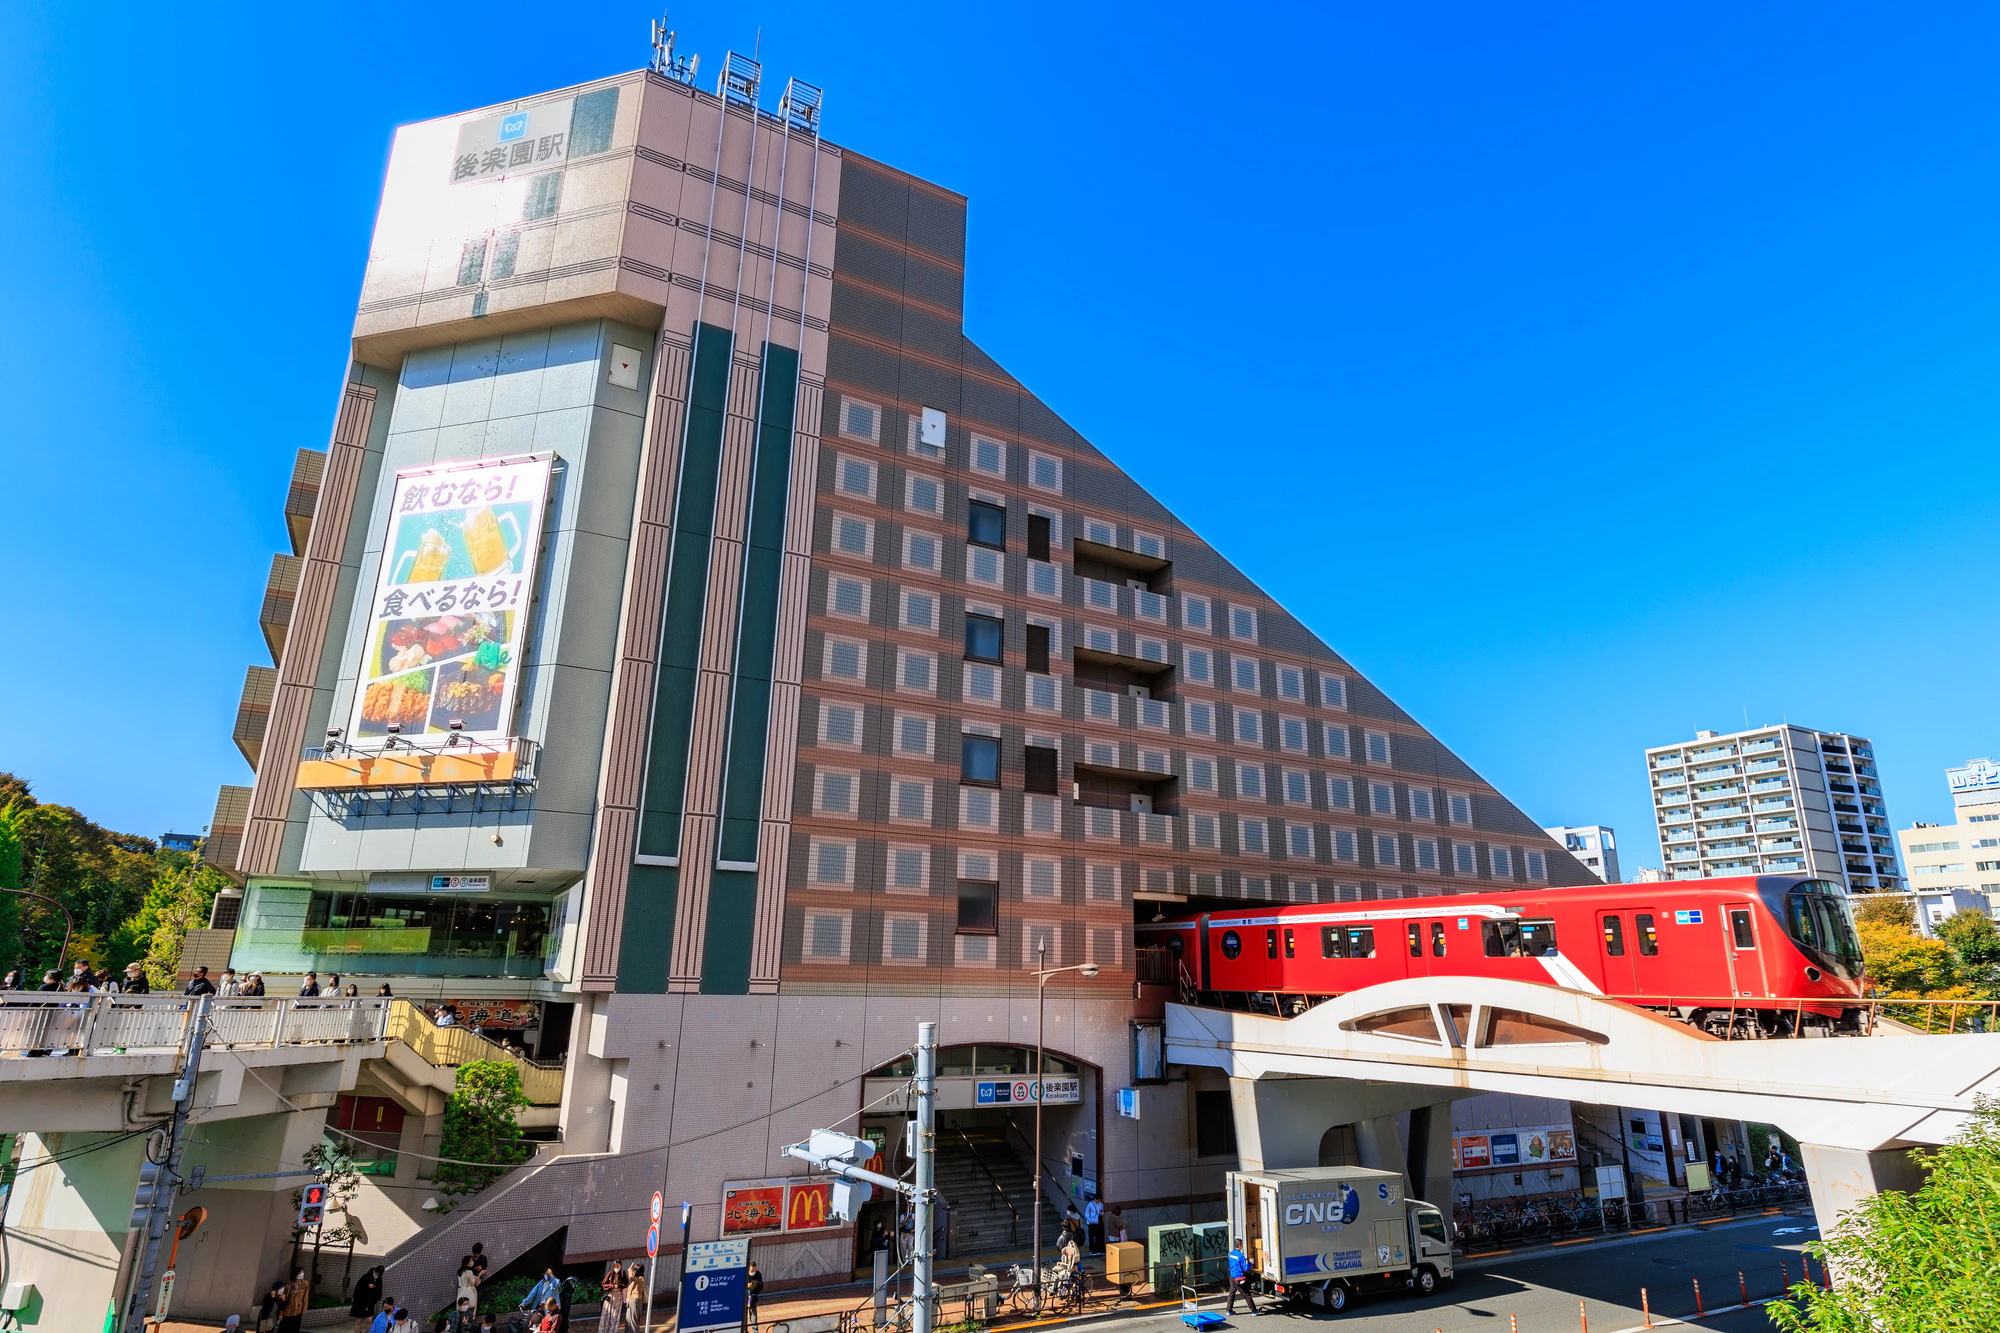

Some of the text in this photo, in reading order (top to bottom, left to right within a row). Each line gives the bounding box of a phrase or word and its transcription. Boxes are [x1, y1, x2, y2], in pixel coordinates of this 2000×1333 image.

[455, 132, 565, 181] 後楽園駅
[400, 475, 518, 513] 飲むなら!
[379, 580, 523, 619] 食べるなら!
[1046, 1081, 1078, 1093] 後楽園駅
[726, 1206, 778, 1221] 北海道
[1285, 1200, 1345, 1227] CNG
[1333, 1260, 1363, 1271] SAGAWA
